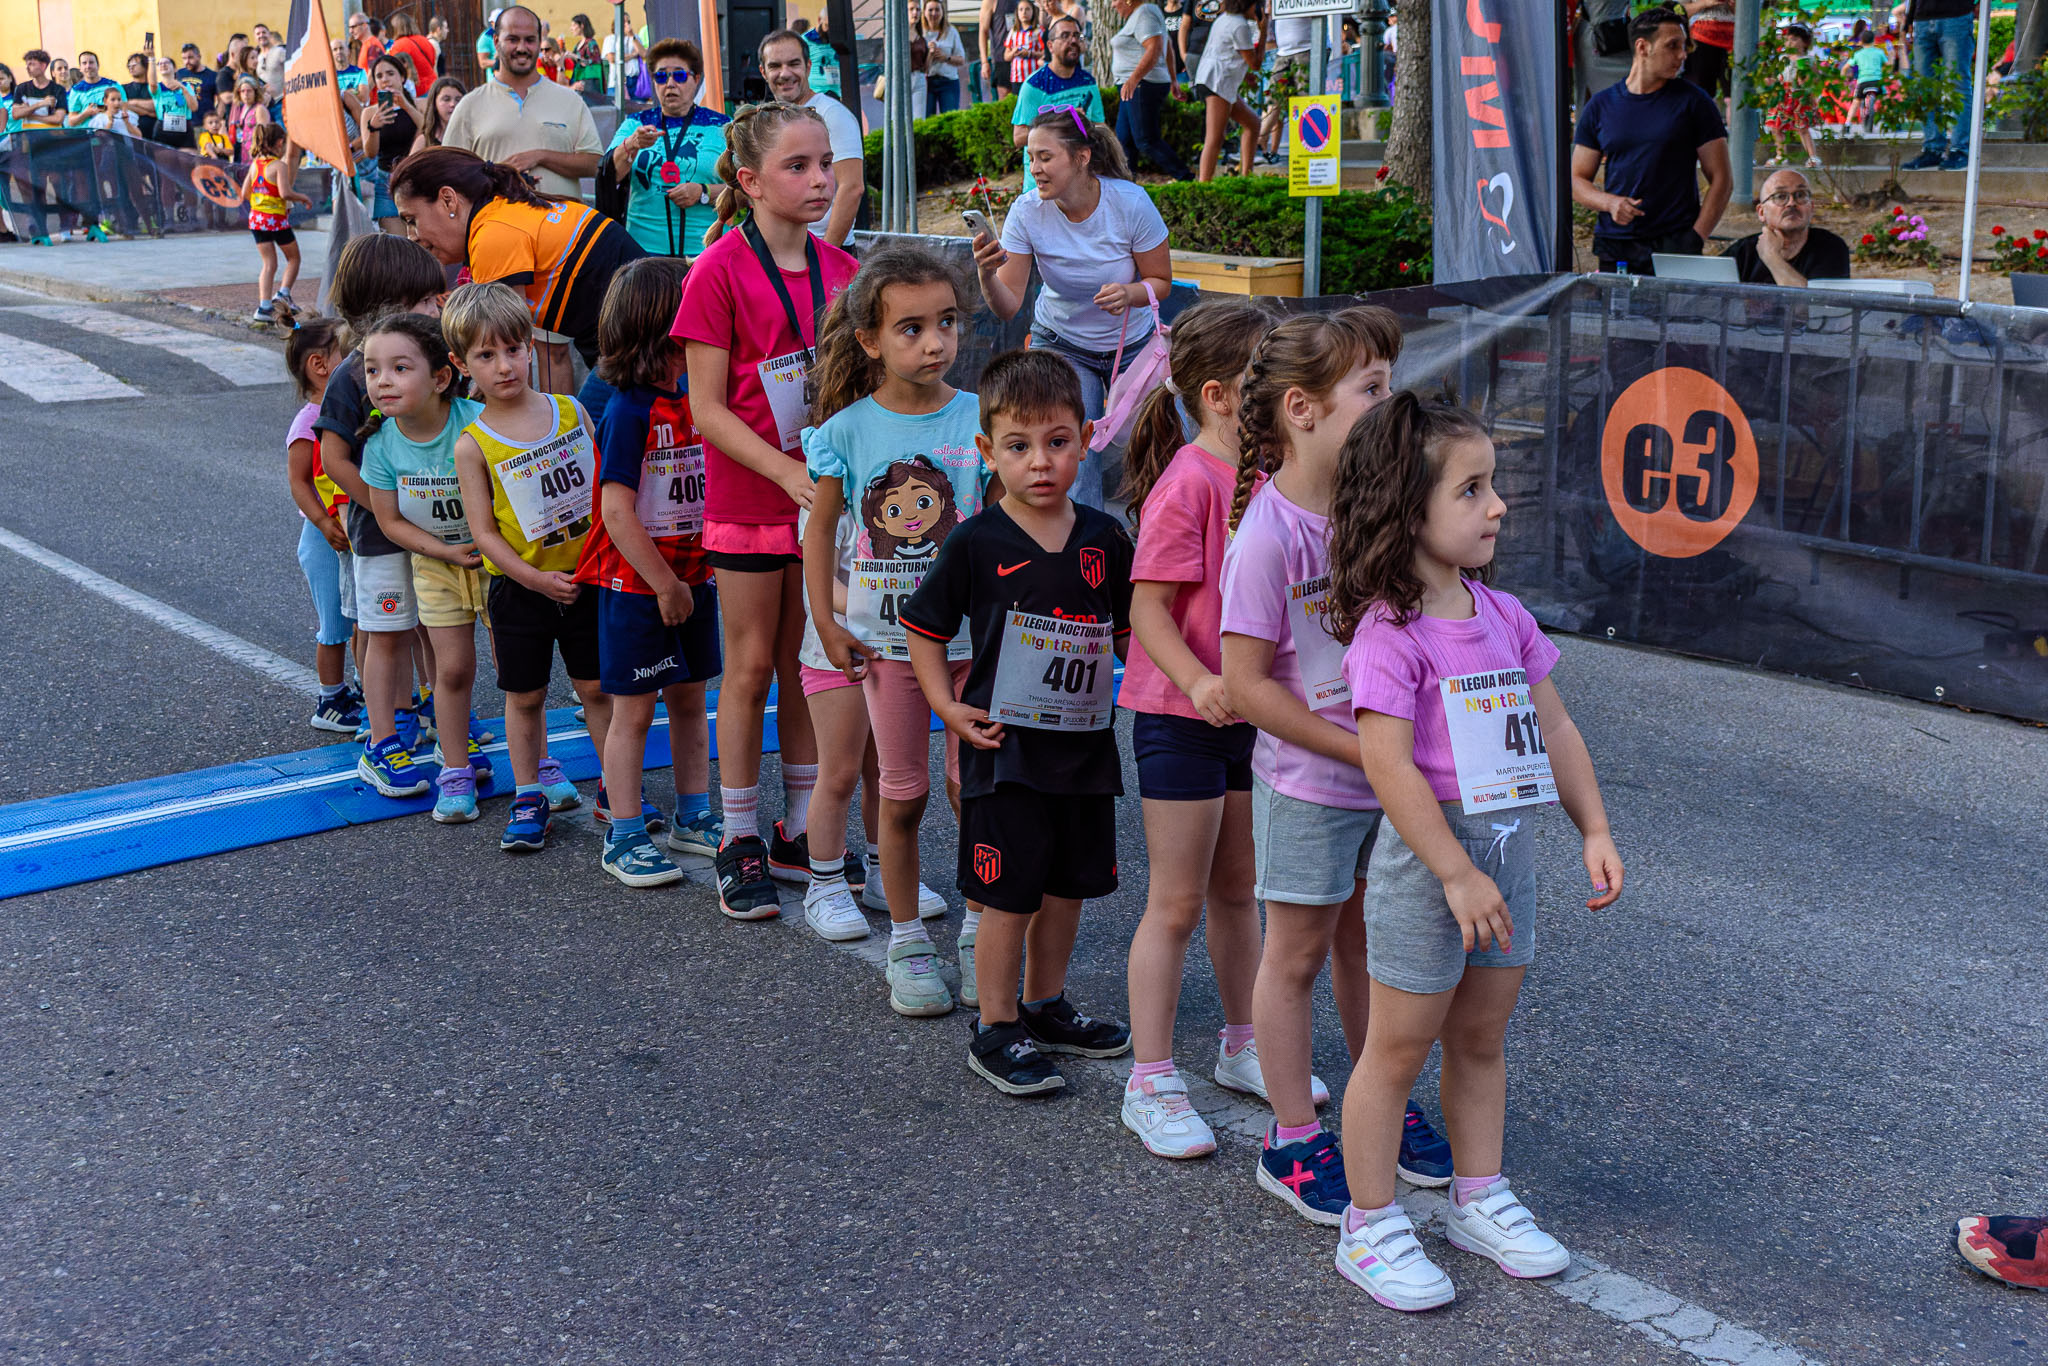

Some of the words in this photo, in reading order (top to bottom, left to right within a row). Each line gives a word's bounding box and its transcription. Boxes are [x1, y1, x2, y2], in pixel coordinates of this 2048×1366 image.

[200, 176, 238, 200] e3
[771, 356, 794, 370] LEGUA
[653, 424, 675, 448] 10
[501, 462, 510, 473] XI
[509, 453, 532, 469] LEGUA
[532, 437, 568, 459] NOCTURNA
[566, 428, 584, 445] UGENA
[646, 451, 672, 462] LEGUA
[933, 444, 977, 464] collecting
[1623, 410, 1736, 522] e3
[408, 477, 430, 486] LEGUA
[541, 459, 586, 499] 405
[669, 473, 705, 504] 406
[409, 487, 462, 499] NightRun
[861, 562, 884, 573] LEGUA
[1292, 585, 1302, 600] XI
[1012, 614, 1025, 627] XI
[1023, 616, 1056, 632] LEGUA
[1058, 622, 1105, 638] NOCTURNA
[1042, 656, 1098, 694] 401
[1449, 679, 1460, 694] XI
[1461, 674, 1496, 692] LEGUA
[1028, 695, 1053, 704] THIAGO
[1315, 684, 1348, 701] MULTIdental
[1505, 711, 1548, 757] 412
[1496, 765, 1527, 776] MARTINA
[1473, 791, 1507, 804] MULTIdental
